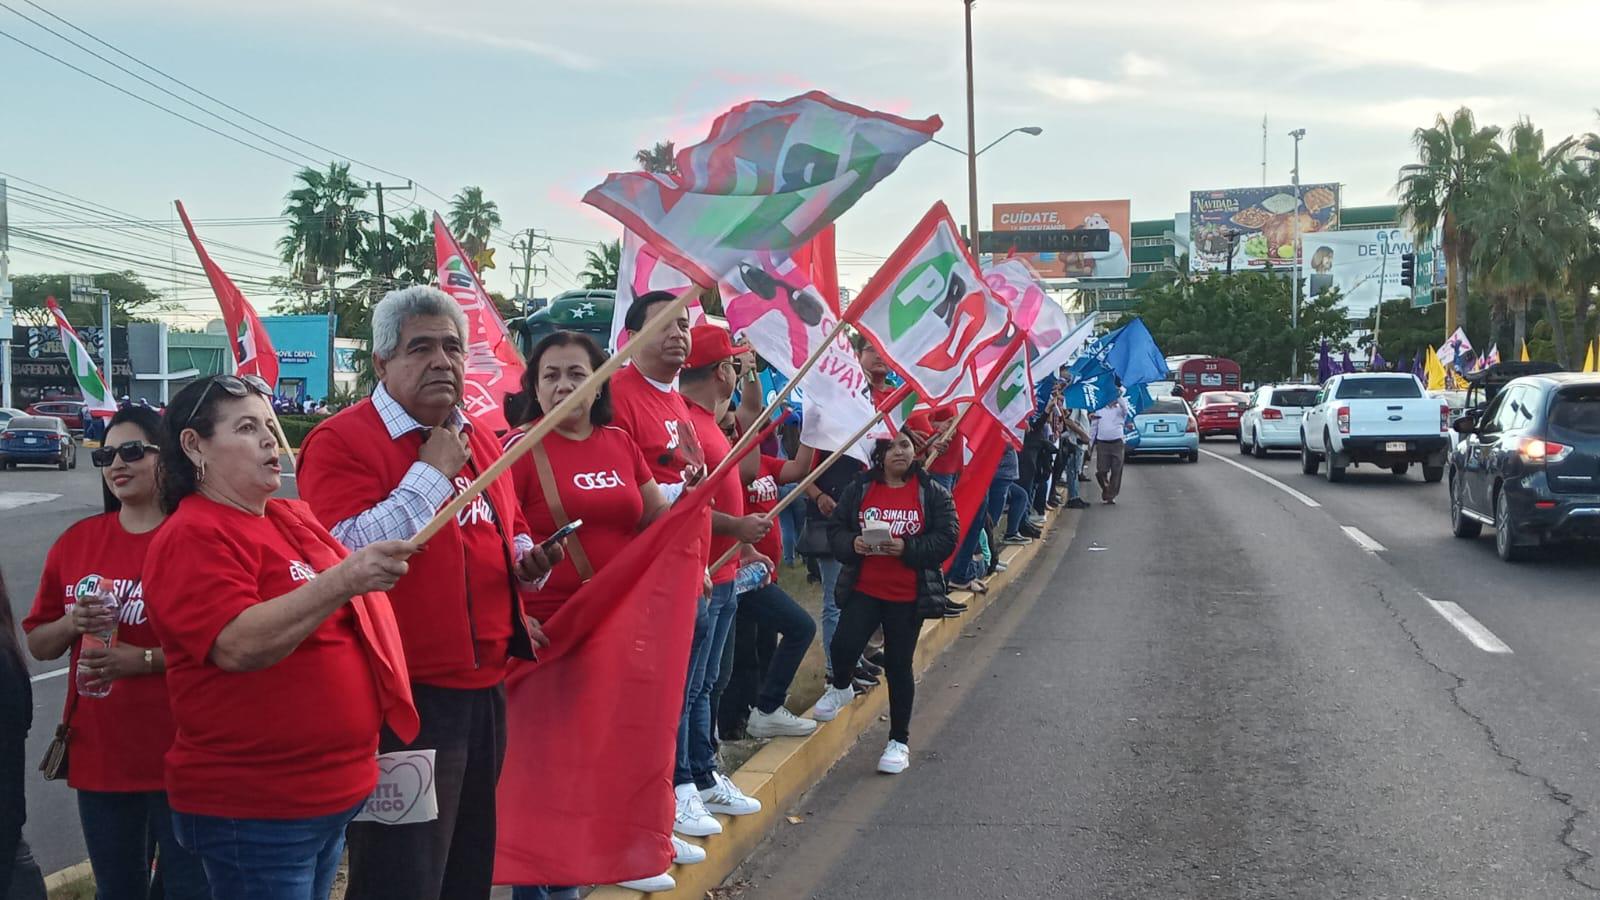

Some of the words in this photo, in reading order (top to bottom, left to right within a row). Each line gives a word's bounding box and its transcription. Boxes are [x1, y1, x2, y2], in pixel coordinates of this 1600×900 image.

[1000, 209, 1061, 225] CUÍDATE,
[1358, 244, 1377, 257] DE
[882, 509, 920, 522] SINALOA
[65, 584, 75, 597] EL
[113, 579, 144, 598] SINA
